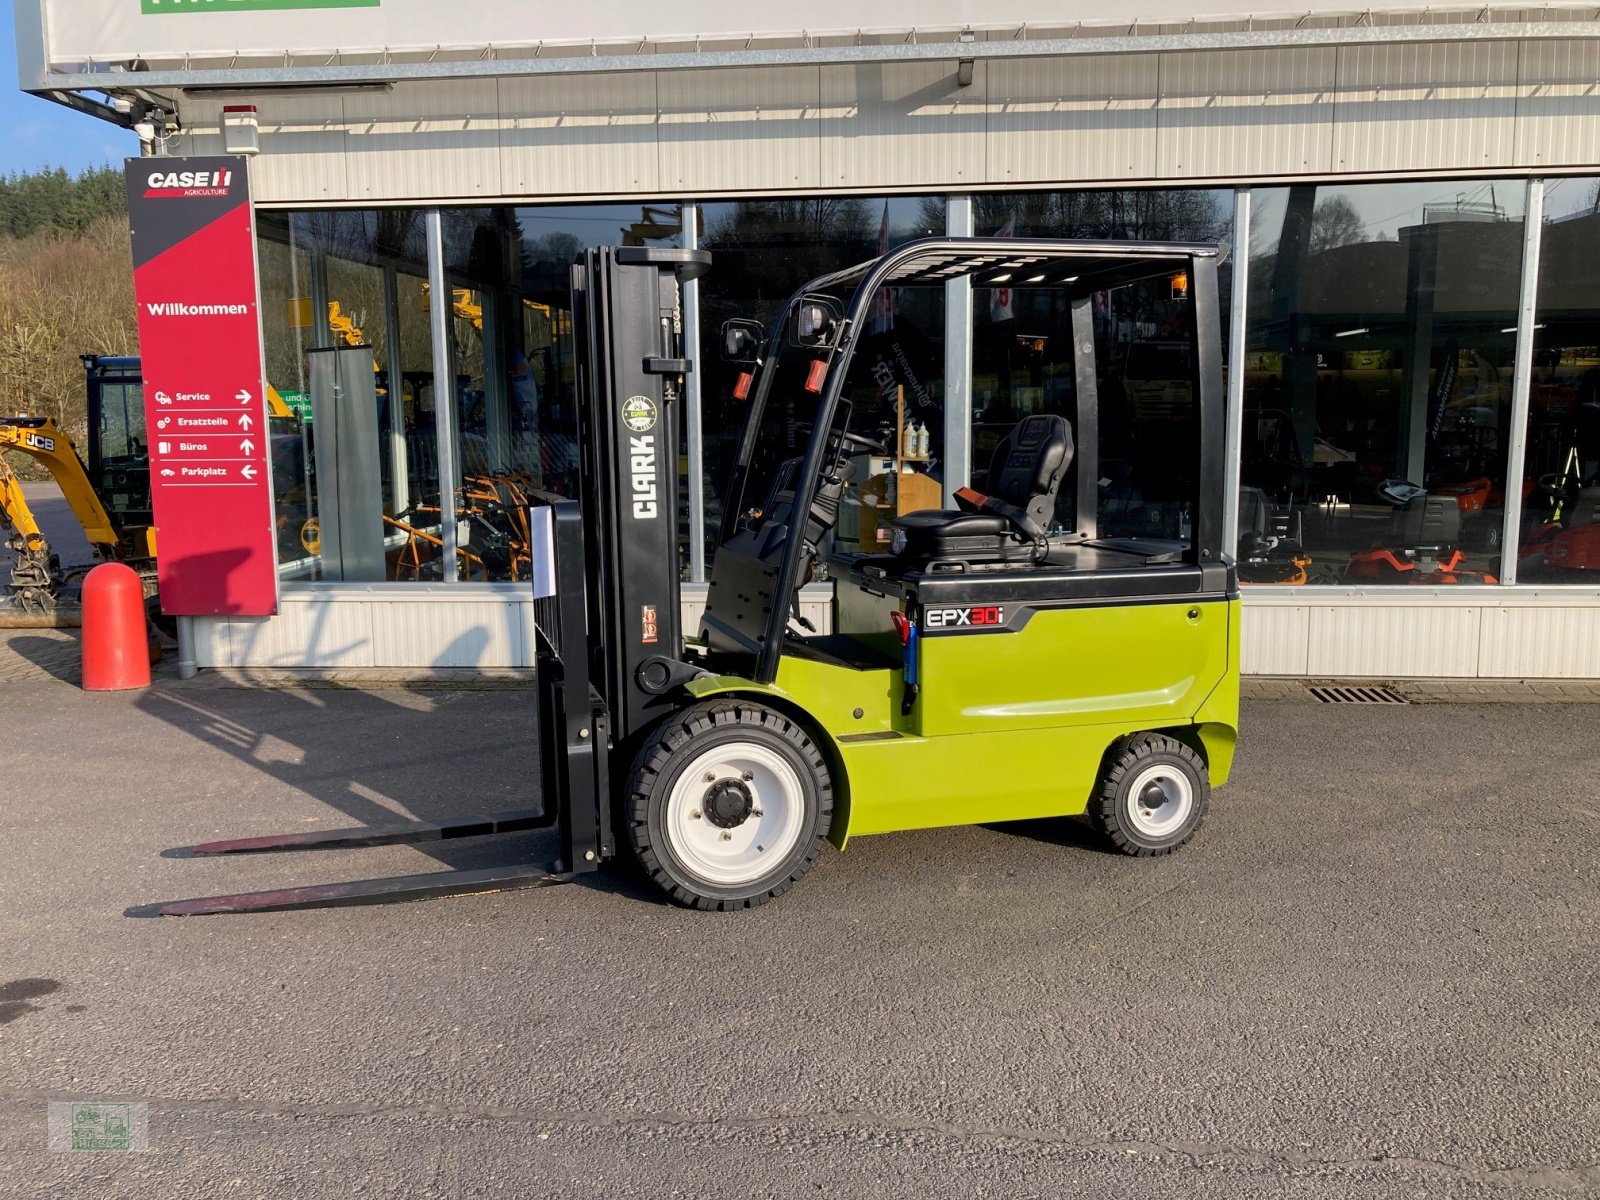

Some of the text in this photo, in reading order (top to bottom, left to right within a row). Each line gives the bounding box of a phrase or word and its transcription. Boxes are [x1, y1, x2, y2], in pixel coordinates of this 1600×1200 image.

[147, 172, 210, 189] CASE
[184, 188, 227, 196] AGRICULTURE
[147, 303, 247, 316] Willkommen
[175, 392, 211, 401] Service
[285, 394, 302, 402] und
[287, 403, 312, 411] schin
[177, 417, 229, 426] Ersatzteile
[26, 433, 54, 451] JCB
[179, 442, 208, 451] Büros
[181, 467, 228, 477] Parkplatz
[630, 435, 658, 519] CLARK
[926, 606, 1004, 627] EPX30i
